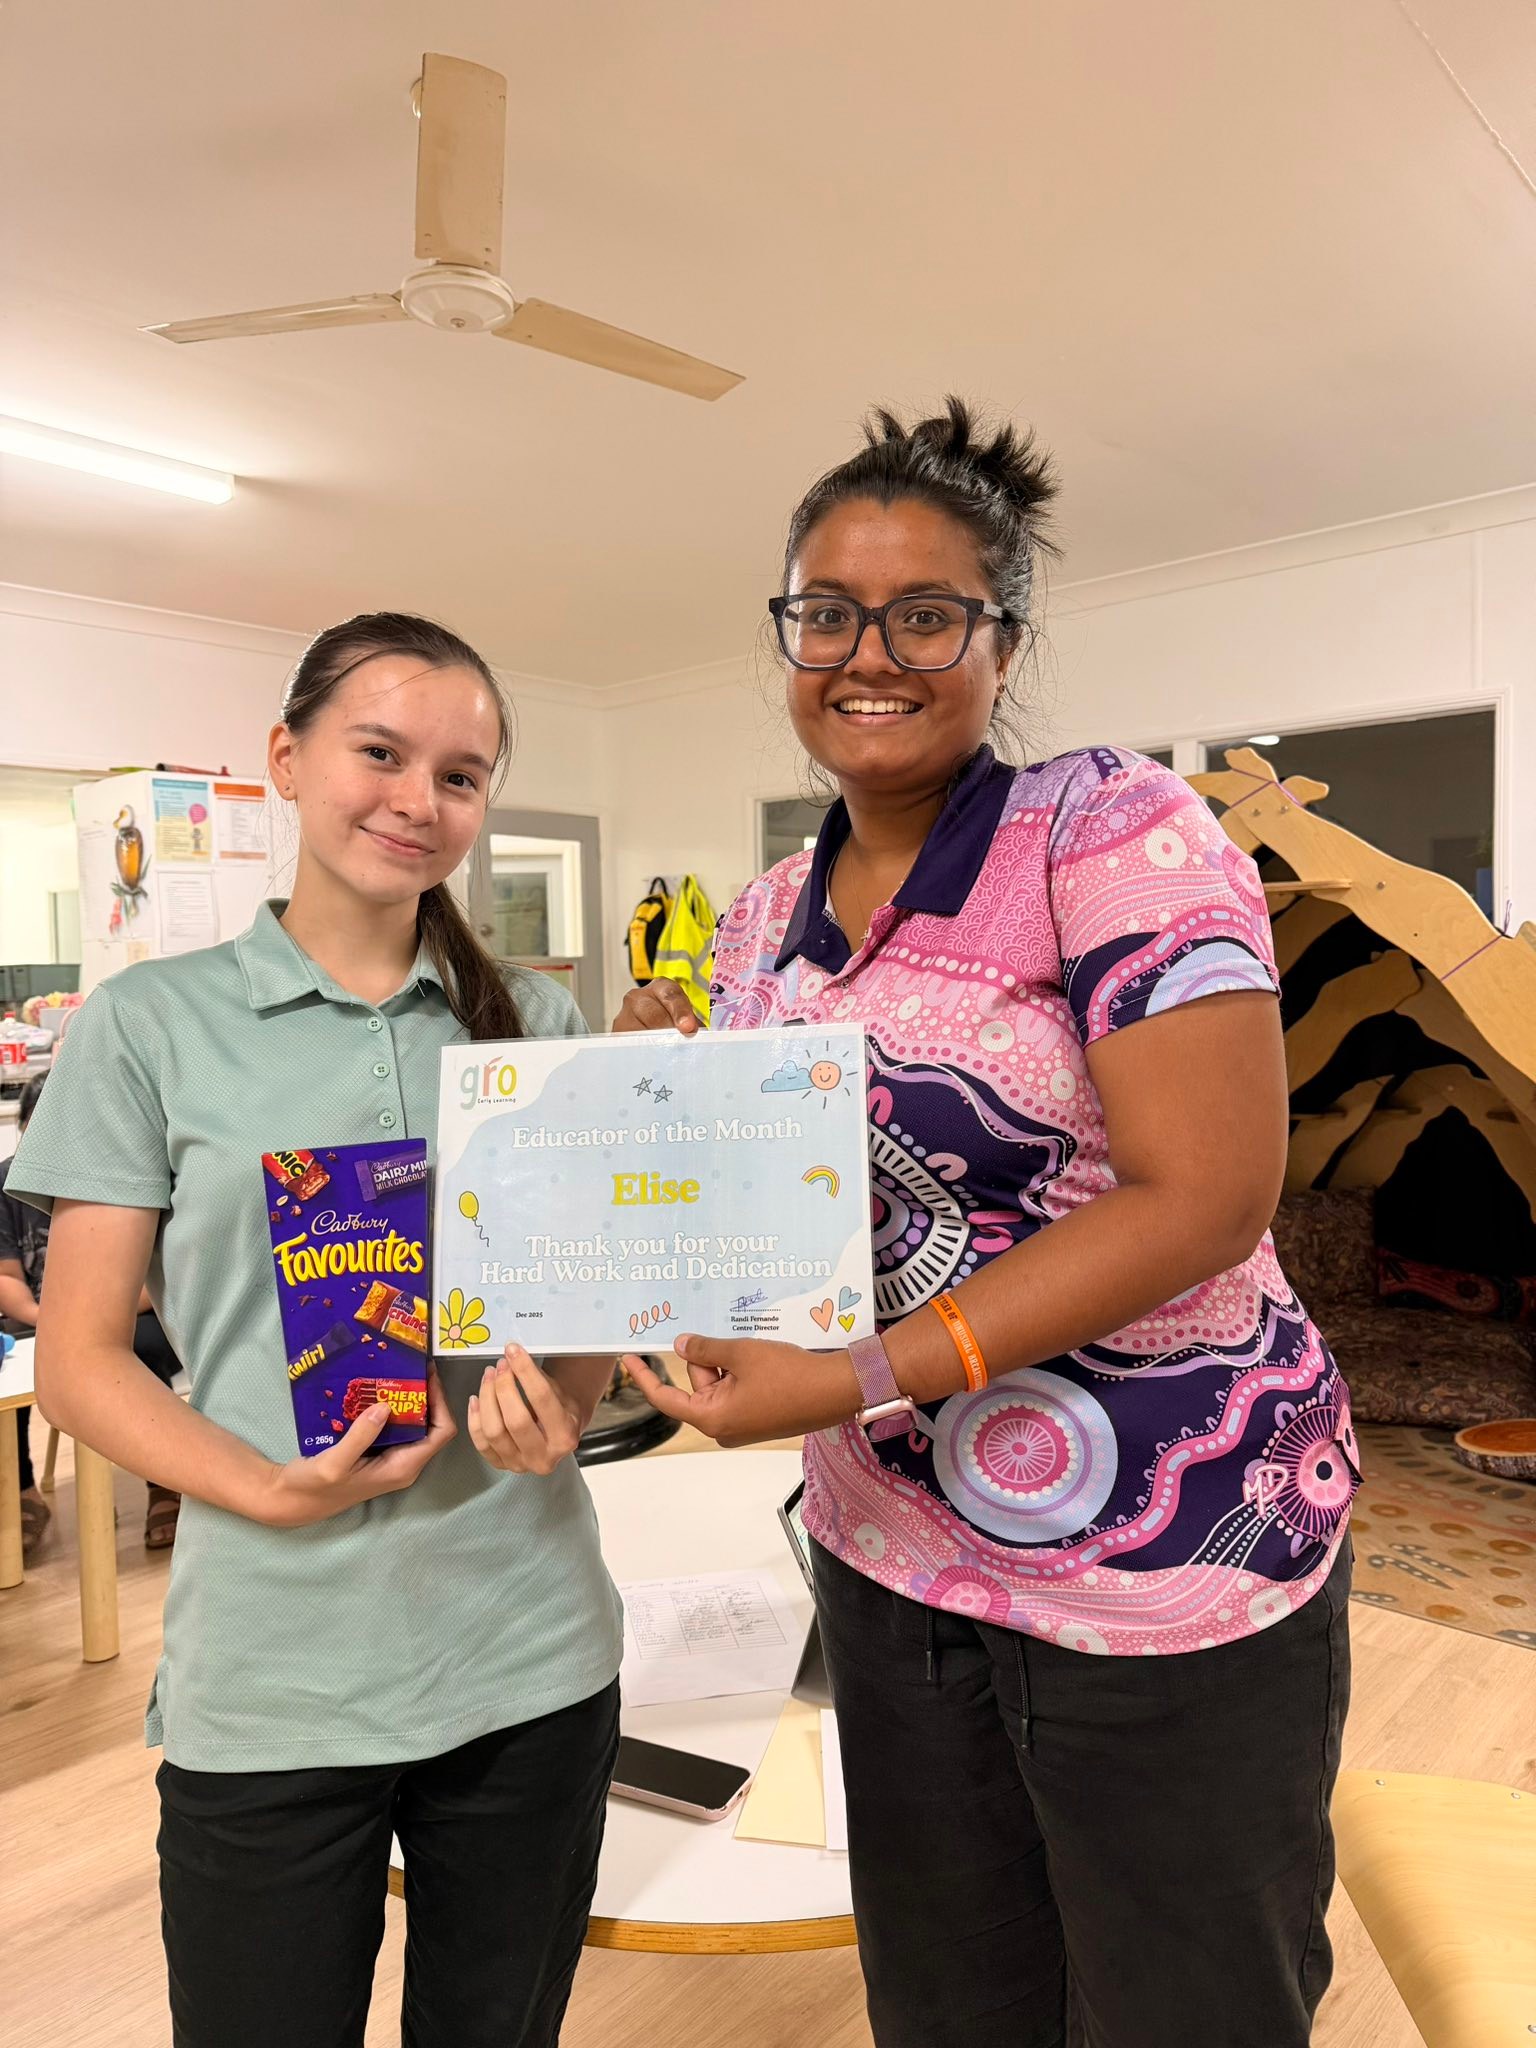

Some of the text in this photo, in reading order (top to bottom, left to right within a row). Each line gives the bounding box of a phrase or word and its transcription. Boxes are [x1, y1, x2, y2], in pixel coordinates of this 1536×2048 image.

[512, 1116, 802, 1149] Educator of the Month
[373, 1165, 409, 1183] DAIRY
[376, 1180, 393, 1191] MILK
[611, 1171, 701, 1206] Elise
[311, 1209, 388, 1235] Cadbury
[273, 1229, 424, 1286] Favourites
[524, 1231, 779, 1261] Thank you for your
[479, 1254, 833, 1285] Hard Work and Dedication
[953, 1320, 973, 1354] UNUSUAL
[387, 1401, 422, 1416] RIPE
[315, 1435, 334, 1445] 265g
